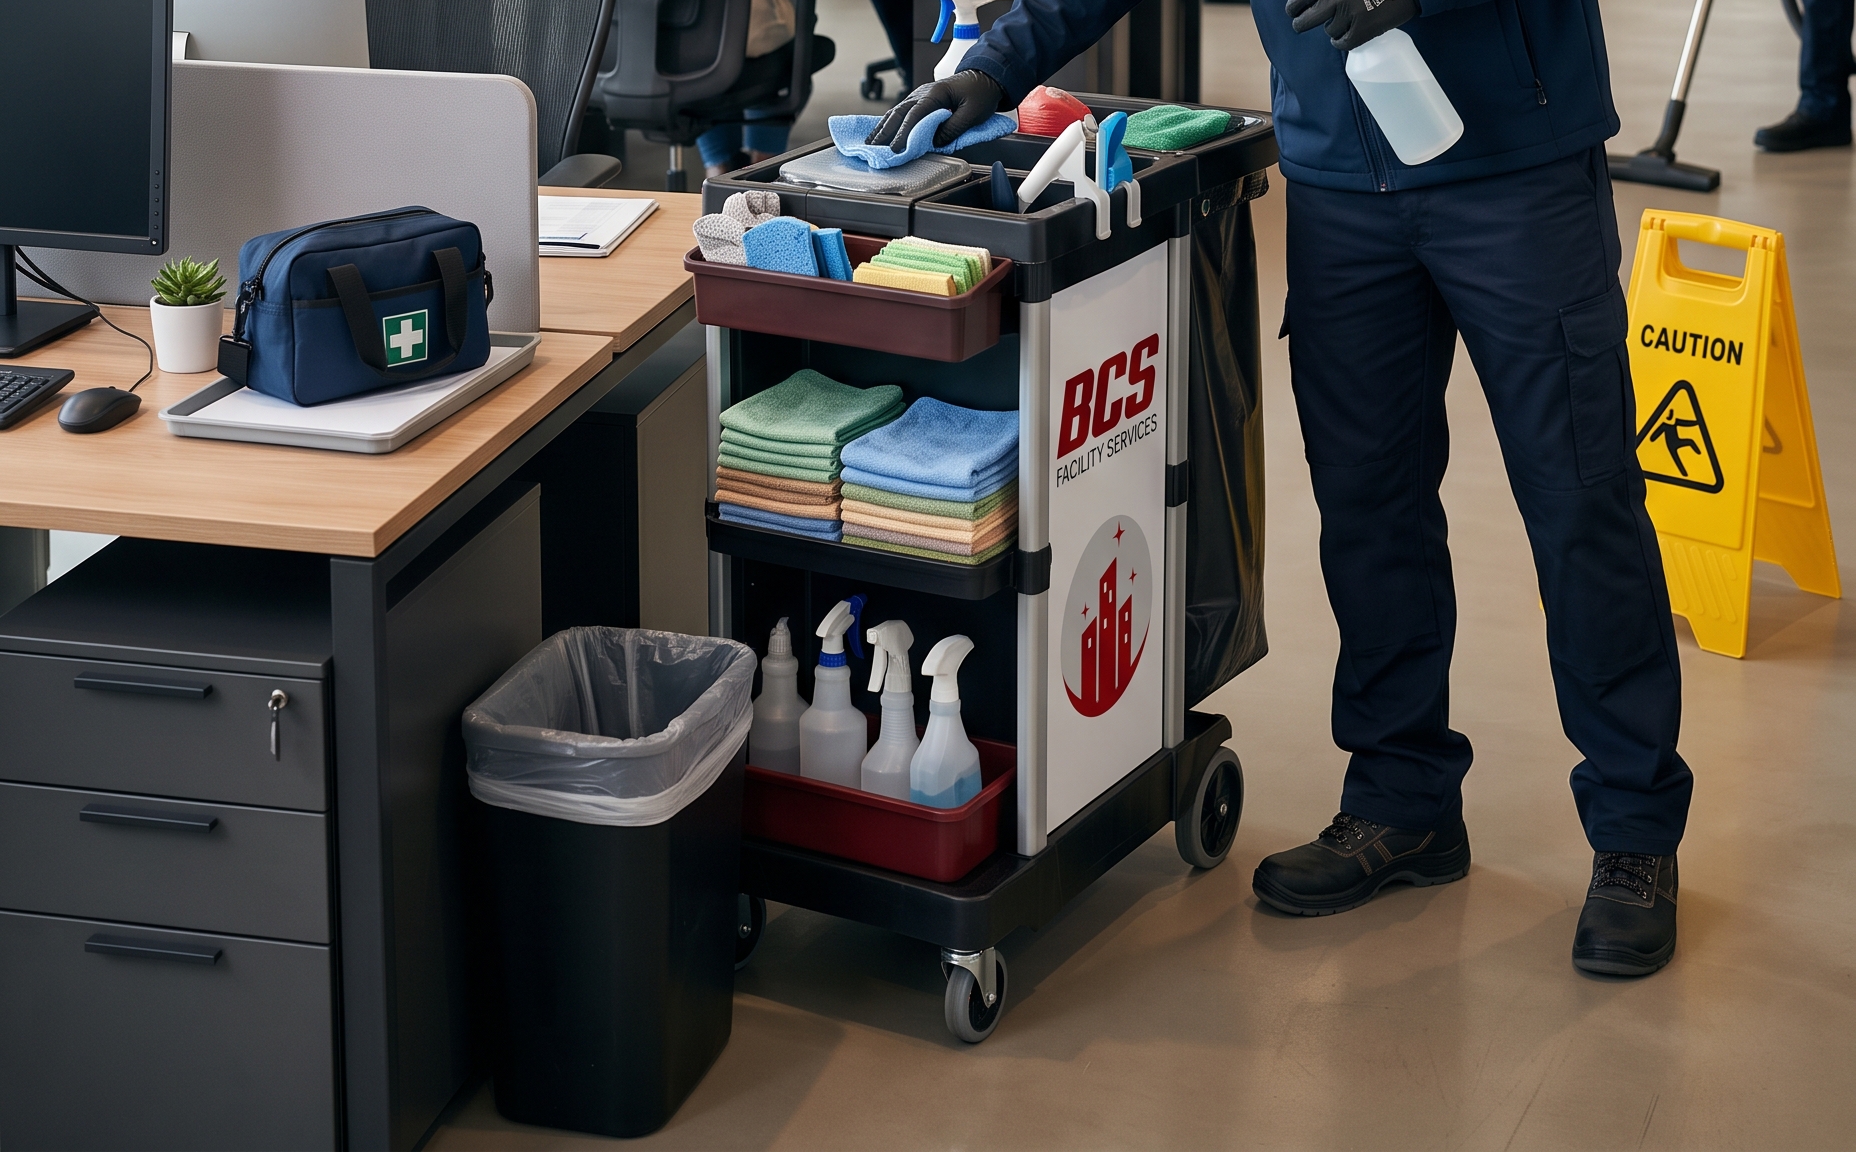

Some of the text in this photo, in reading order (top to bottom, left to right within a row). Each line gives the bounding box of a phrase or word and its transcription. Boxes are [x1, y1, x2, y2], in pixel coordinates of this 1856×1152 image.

[1641, 324, 1744, 366] CAUTION
[1057, 333, 1160, 460] BCS
[1056, 413, 1158, 488] FACILITY SERVICES
